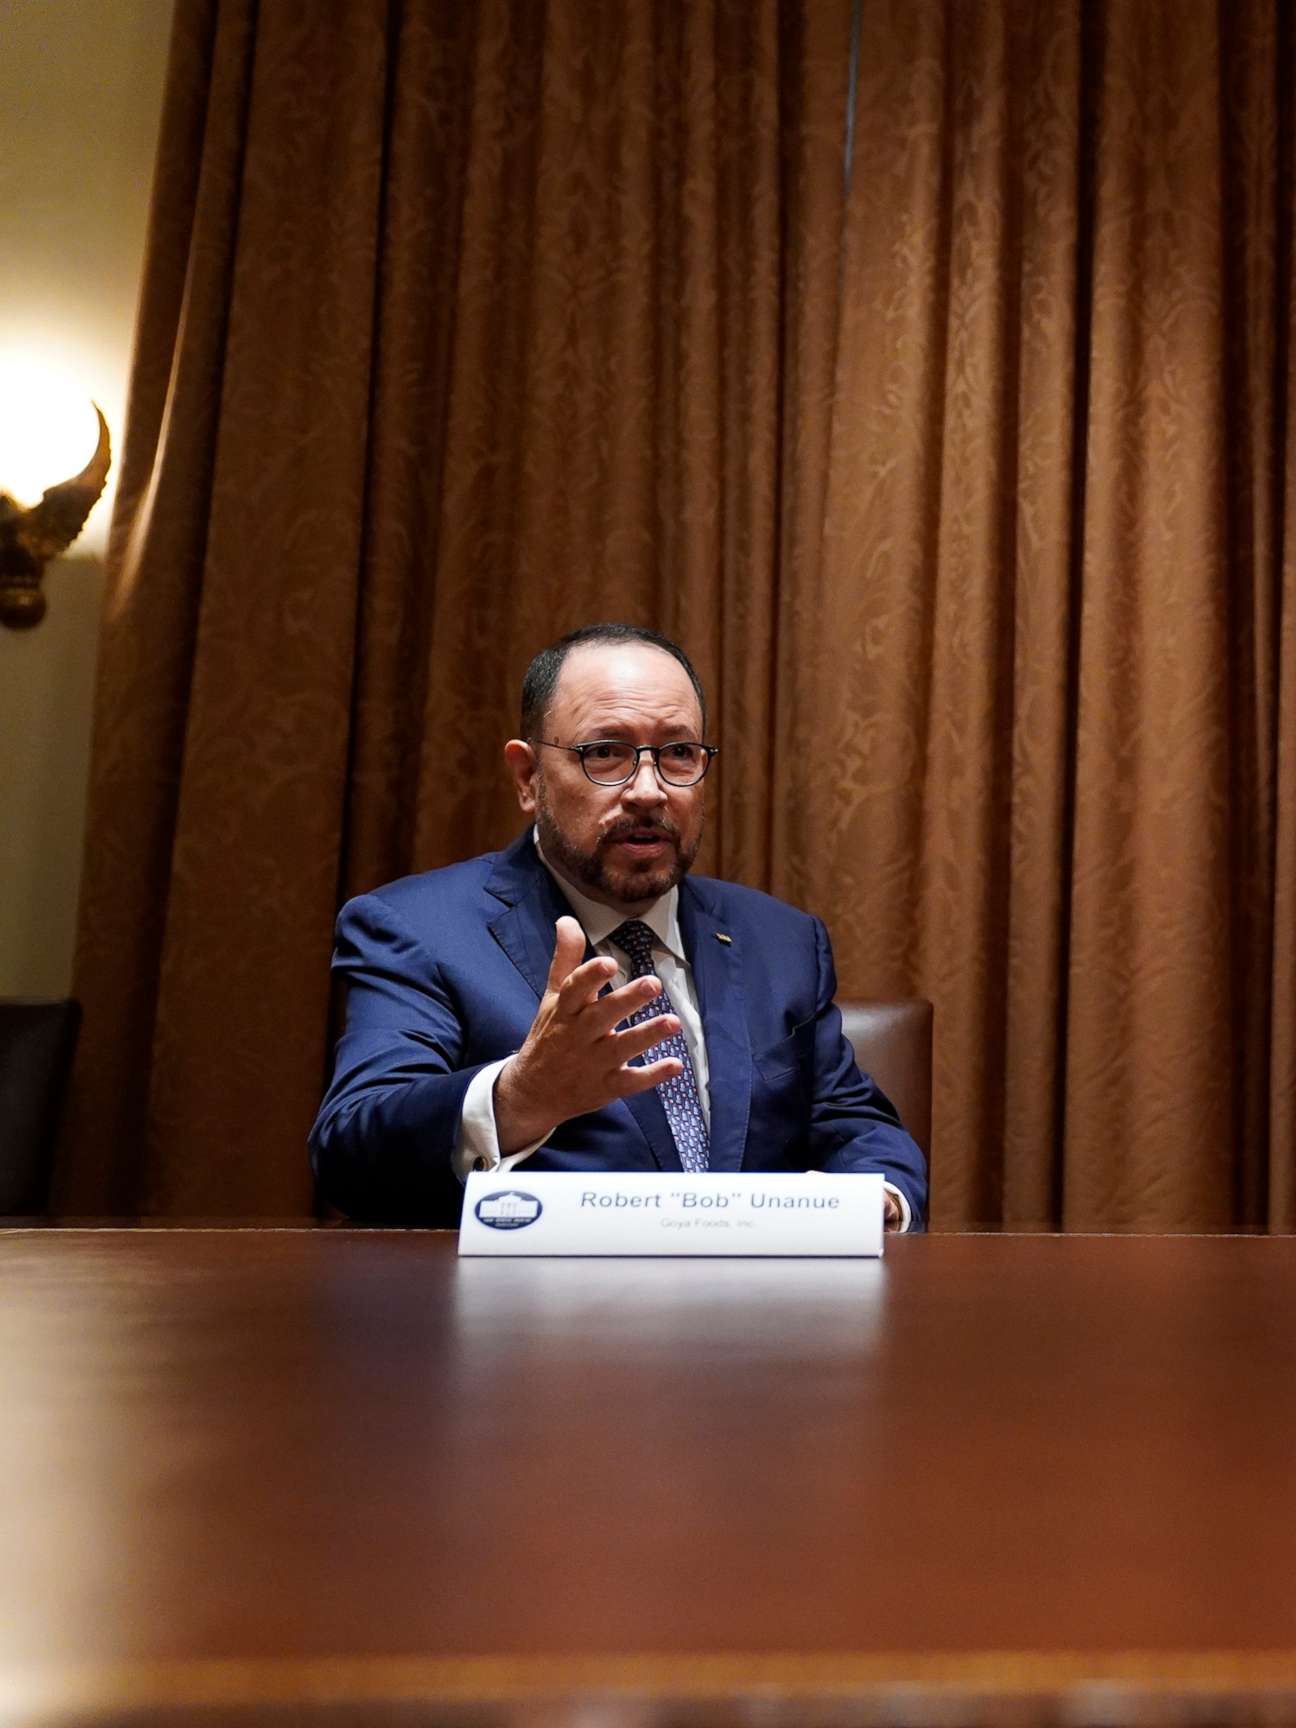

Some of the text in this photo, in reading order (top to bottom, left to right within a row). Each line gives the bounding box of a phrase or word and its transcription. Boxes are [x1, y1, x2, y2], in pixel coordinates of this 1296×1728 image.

[580, 1191, 841, 1209] Robert "Bob" Unanue
